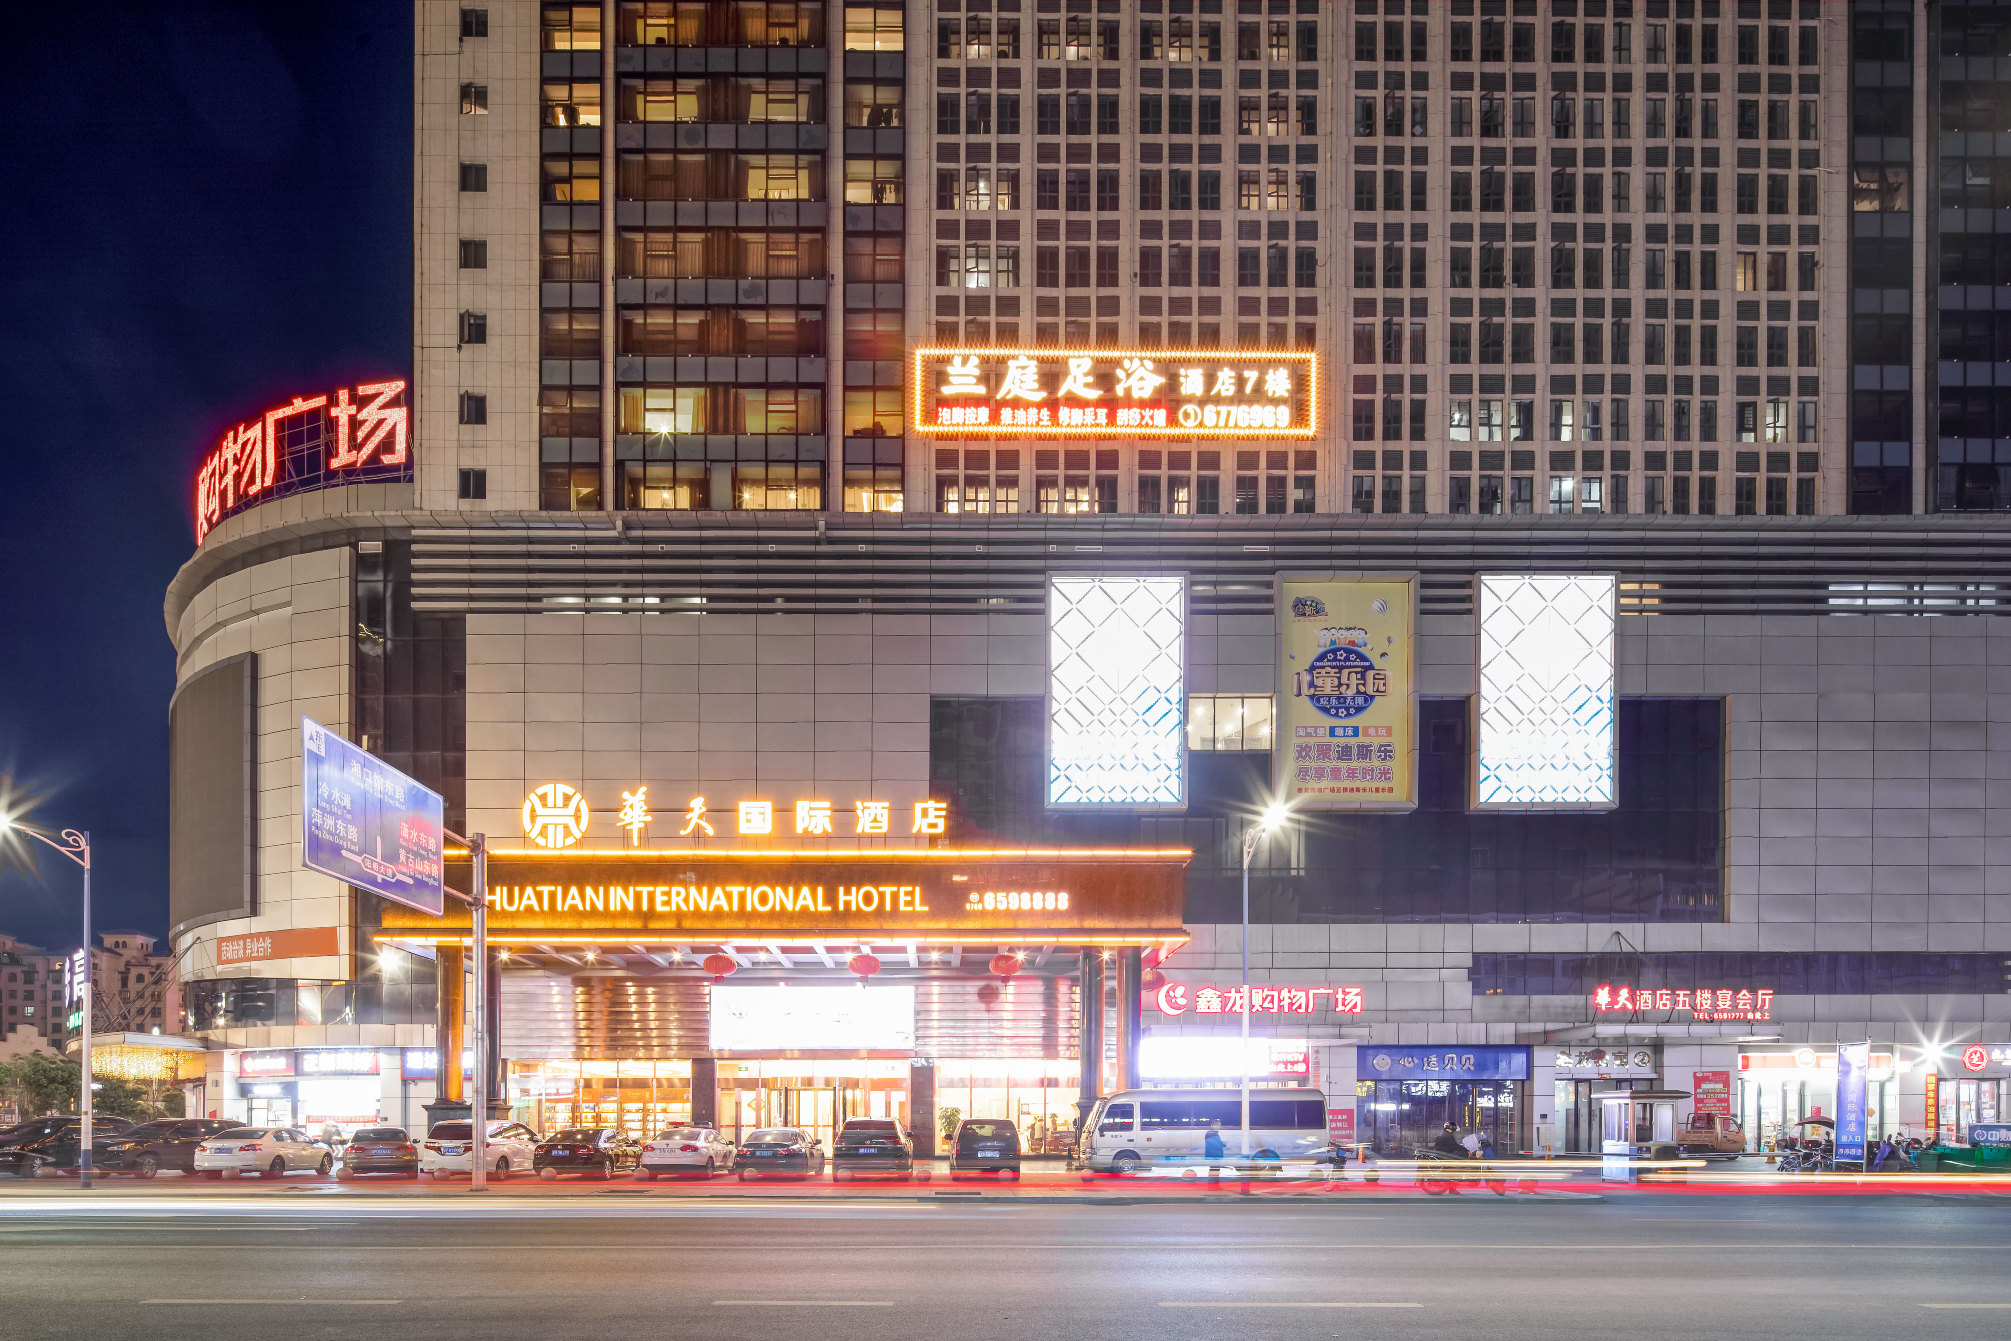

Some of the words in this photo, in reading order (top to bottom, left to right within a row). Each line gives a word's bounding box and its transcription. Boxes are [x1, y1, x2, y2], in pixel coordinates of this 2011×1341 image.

[941, 355, 1166, 401] 兰庭足浴
[197, 379, 408, 546] 购物广场
[1291, 666, 1393, 697] 儿童乐园
[1367, 727, 1387, 737] 电玩
[1293, 742, 1395, 763] 欢聚迪斯乐
[1295, 765, 1393, 783] 尽享童年时光
[318, 780, 352, 810] 冷水滩
[609, 886, 832, 912] INTERNATIONAL
[839, 886, 929, 912] HOTEL
[984, 892, 1068, 910] 6598888
[1195, 987, 1363, 1013] 鑫龙购物广场
